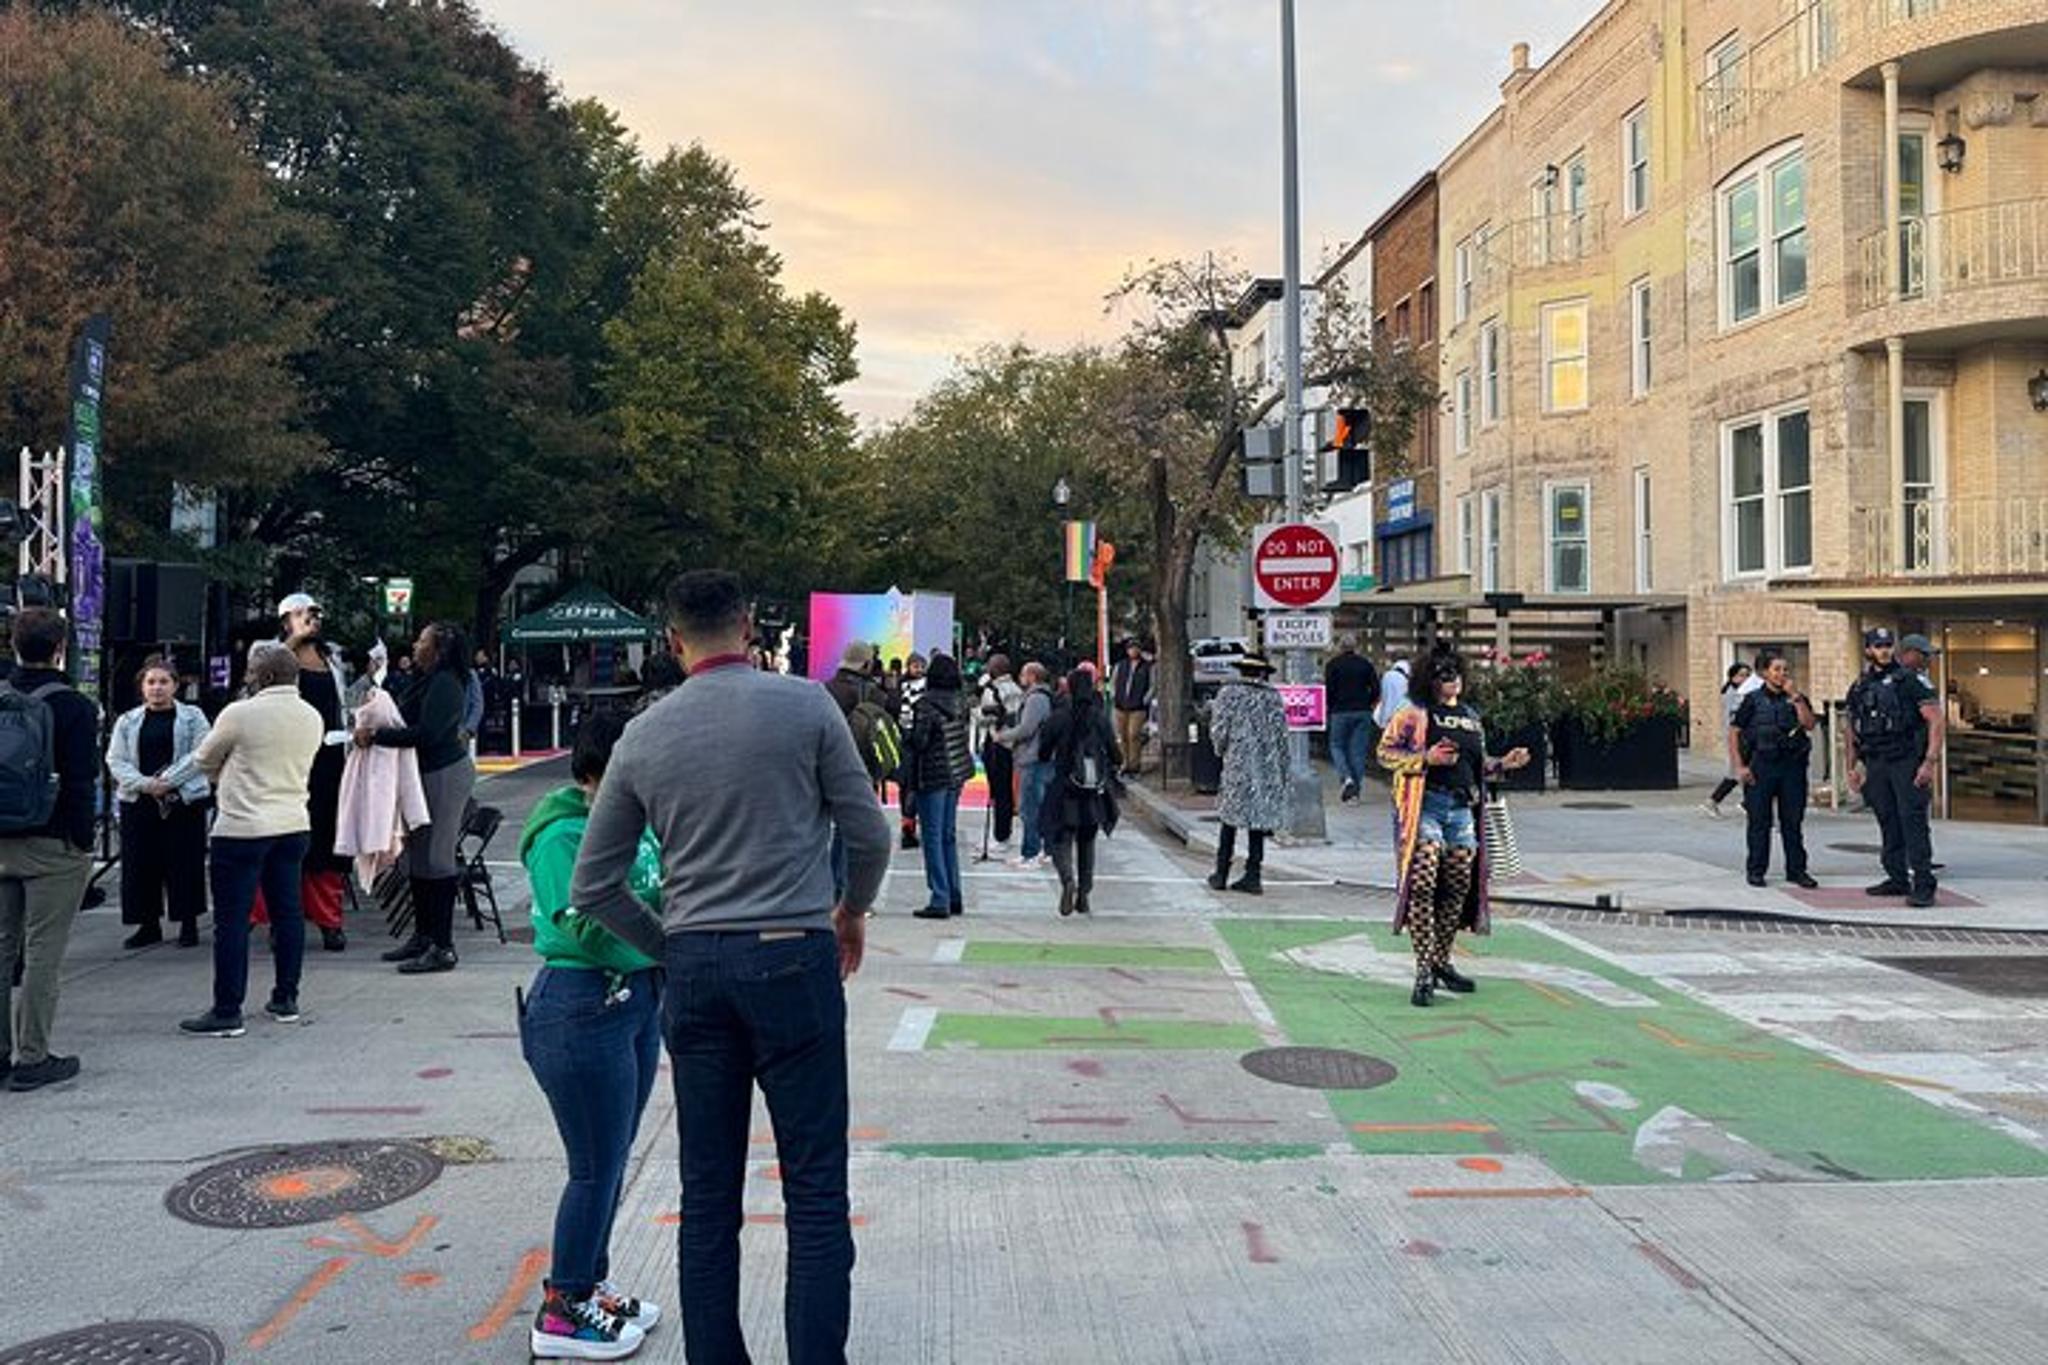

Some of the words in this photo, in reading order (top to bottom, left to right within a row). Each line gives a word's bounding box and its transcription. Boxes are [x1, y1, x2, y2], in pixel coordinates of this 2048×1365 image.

[1266, 540, 1287, 556] DO
[1295, 539, 1326, 554] NOT
[1273, 576, 1321, 592] ENTER
[1277, 620, 1320, 630] EXCEPT
[511, 628, 579, 641] Community
[582, 626, 647, 638] Recreation
[1272, 631, 1325, 643] BICYCLES
